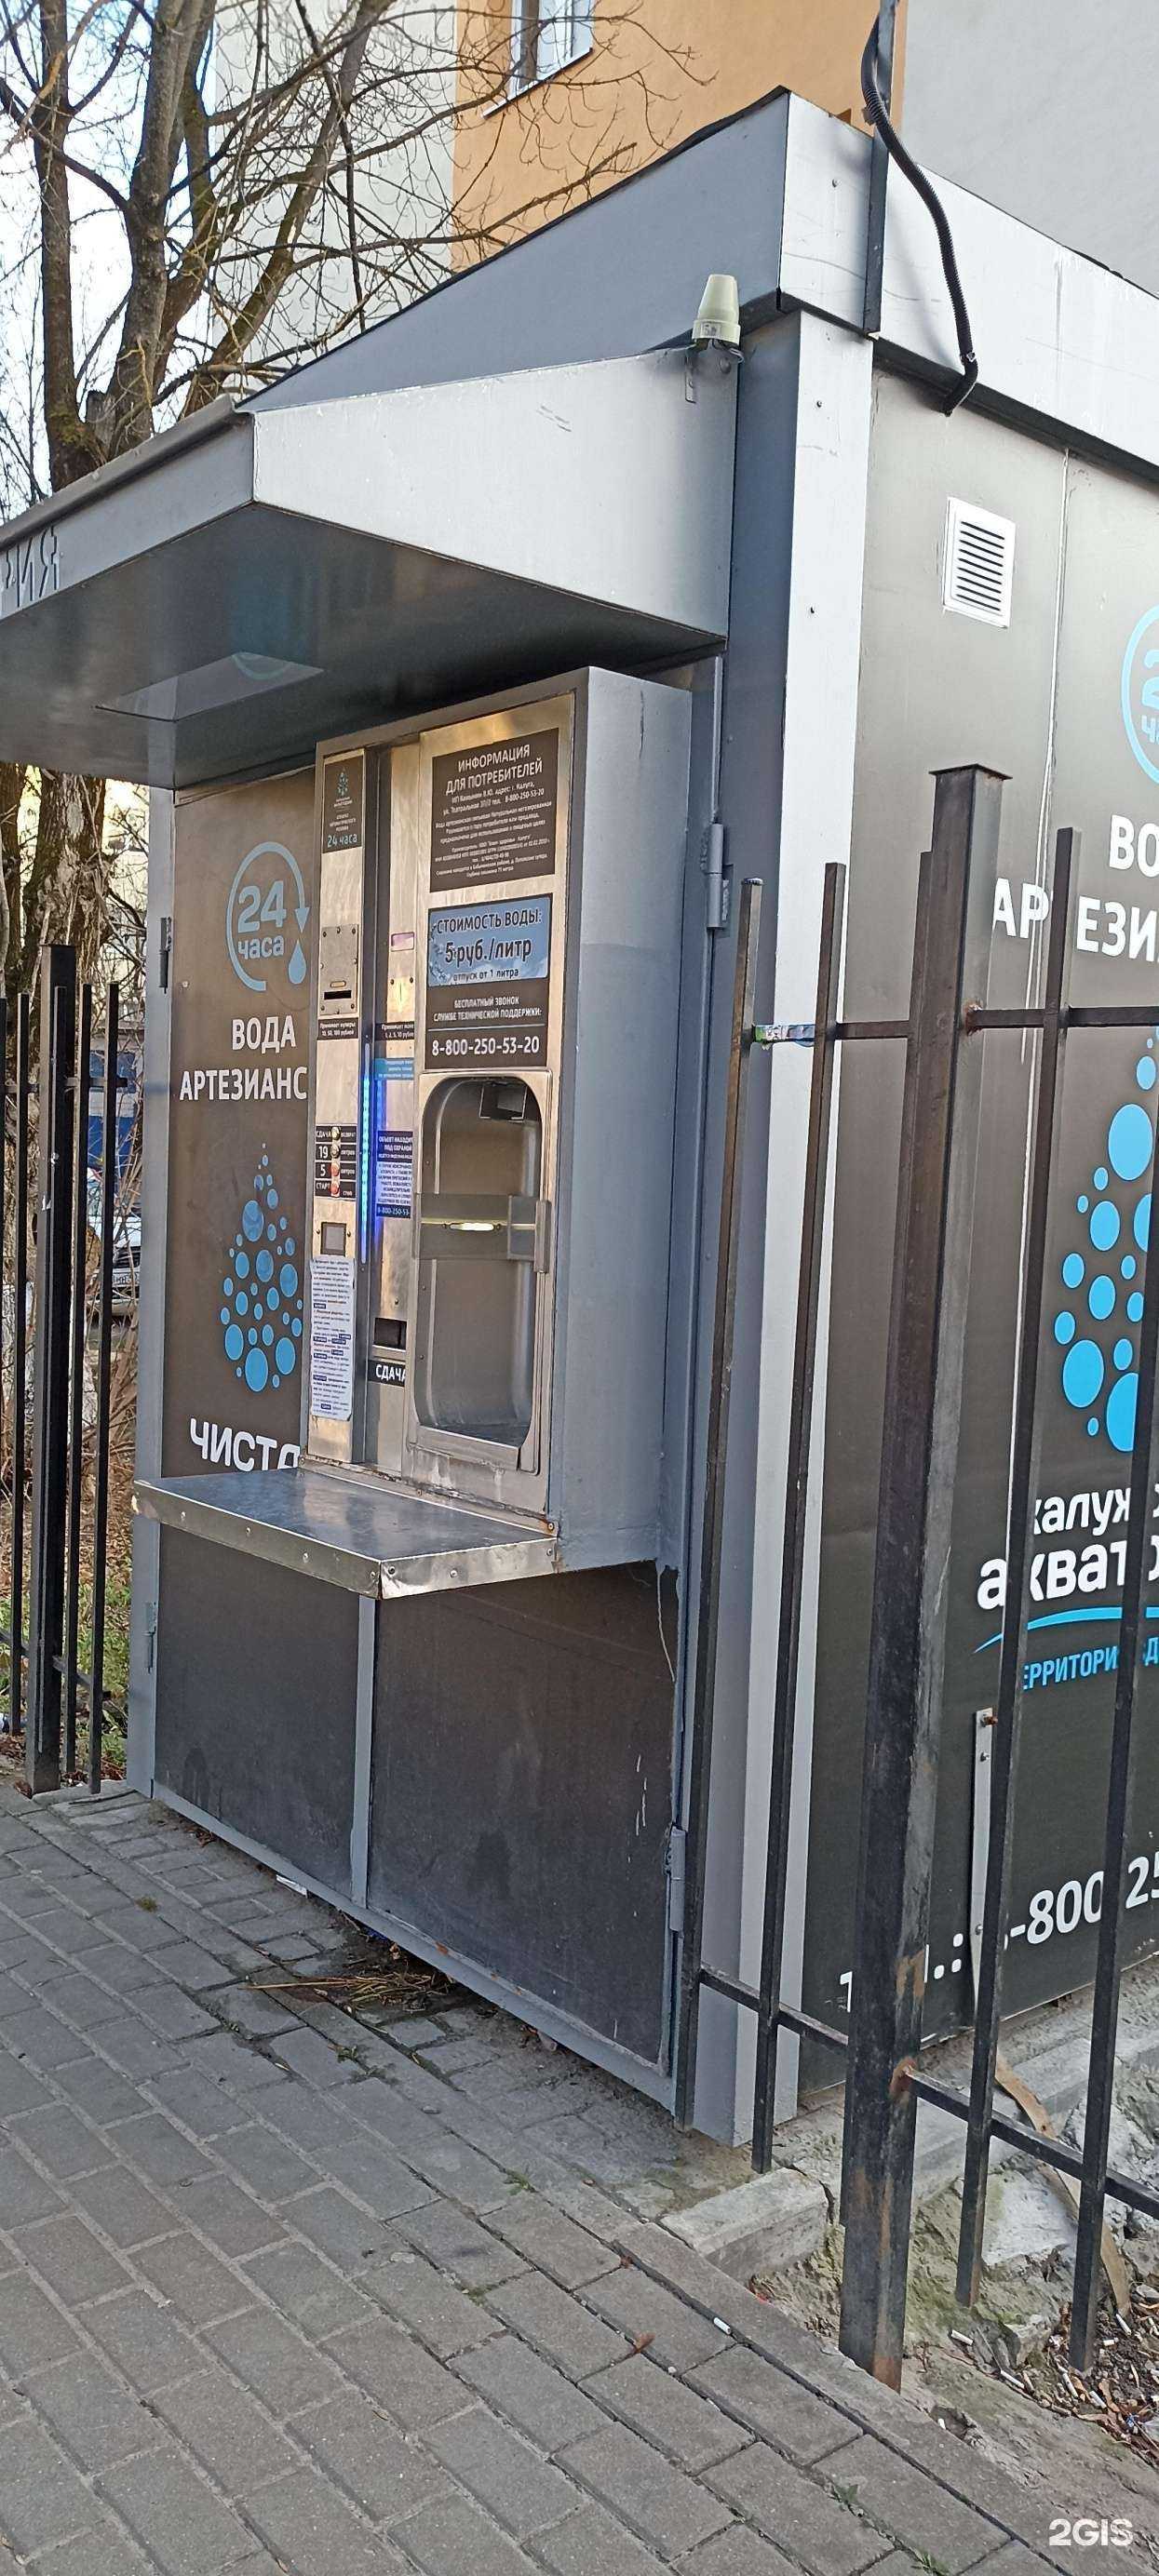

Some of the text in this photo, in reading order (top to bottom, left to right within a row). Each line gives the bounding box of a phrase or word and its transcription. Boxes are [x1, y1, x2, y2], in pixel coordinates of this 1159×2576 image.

[458, 744, 530, 772] ИНФОРМАЦИЯ
[445, 757, 543, 796] ДЛЯ ПОТРЕБИТЕЛЕЙ
[505, 787, 545, 803] 8-800-250-53-20
[327, 833, 357, 848] 24 часа
[237, 880, 288, 933] 24
[437, 908, 542, 933] СТОИМОСТЬ ВОДЫ:
[992, 878, 1159, 962] АРЕЗИ
[237, 934, 285, 960] часа
[445, 937, 532, 967] 5 руб./литр
[452, 972, 478, 983] отпуск
[478, 971, 488, 980] от
[496, 968, 519, 979] литра
[433, 1007, 543, 1022] СЛУЖБЕ ТЕХНИЧЕСКОЙ ПОДДЕРЖКИ:
[454, 996, 519, 1008] БЕСПЛАТНЫЙ ЗВОНОК
[232, 1015, 296, 1054] ВОДА
[432, 1035, 540, 1056] 8-800-250-53-20
[180, 1067, 308, 1101] АРТЕЗИАНС
[318, 1145, 329, 1160] 19
[319, 1163, 327, 1177] 5
